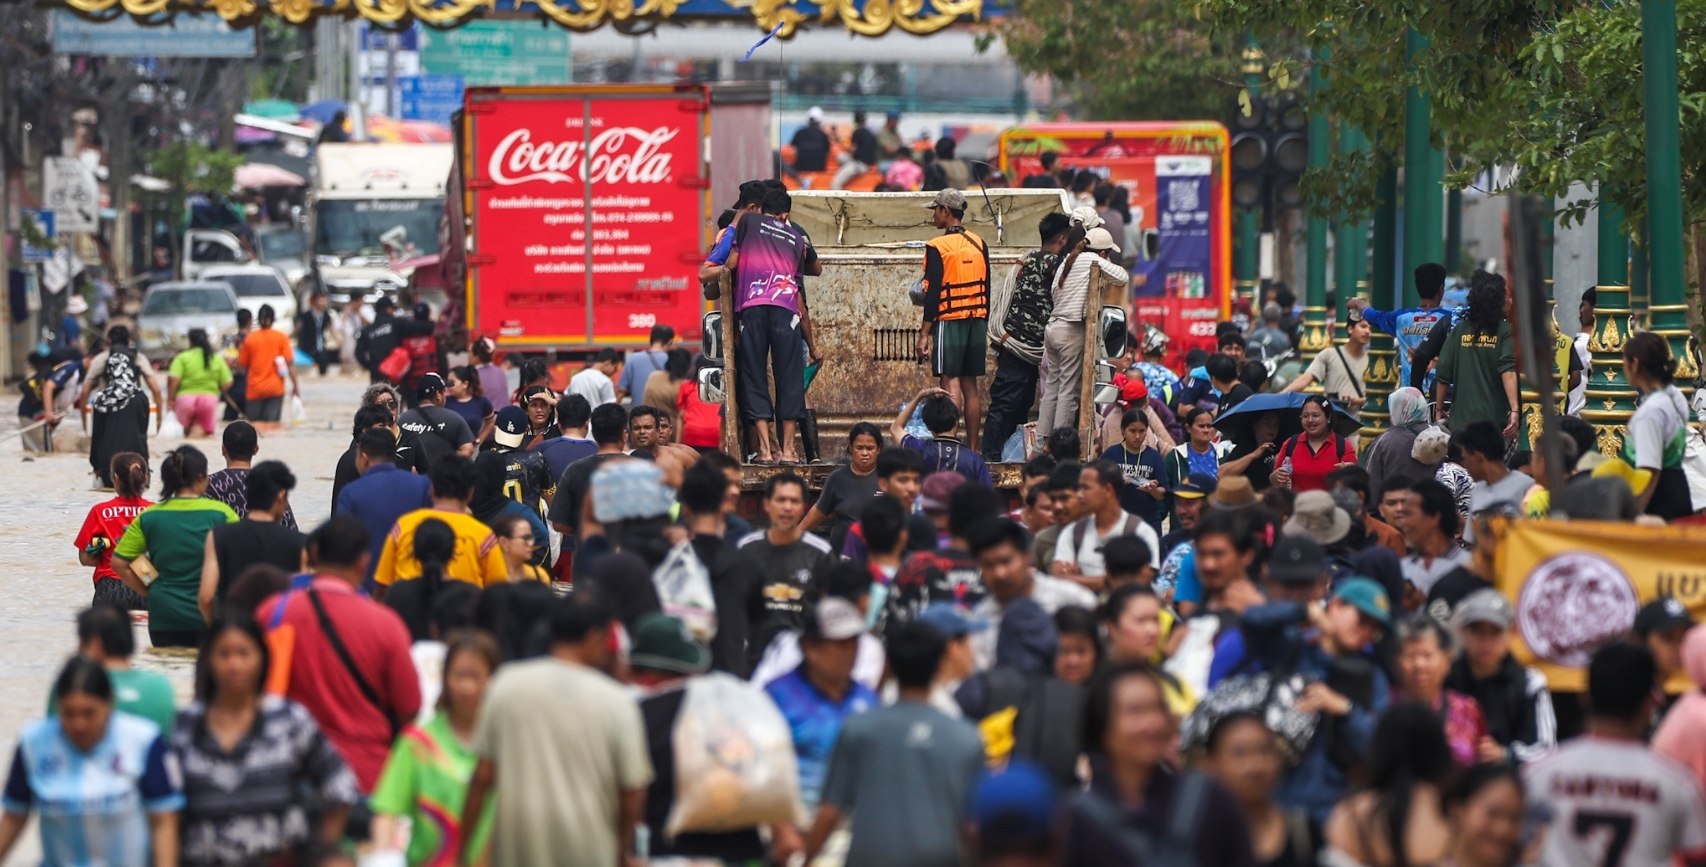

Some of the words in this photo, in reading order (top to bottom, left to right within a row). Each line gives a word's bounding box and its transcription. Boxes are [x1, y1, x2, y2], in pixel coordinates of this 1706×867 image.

[489, 127, 680, 185] Coca-Cola
[1189, 321, 1217, 336] 433
[102, 506, 147, 519] OPTIO
[1574, 811, 1636, 867] 7
